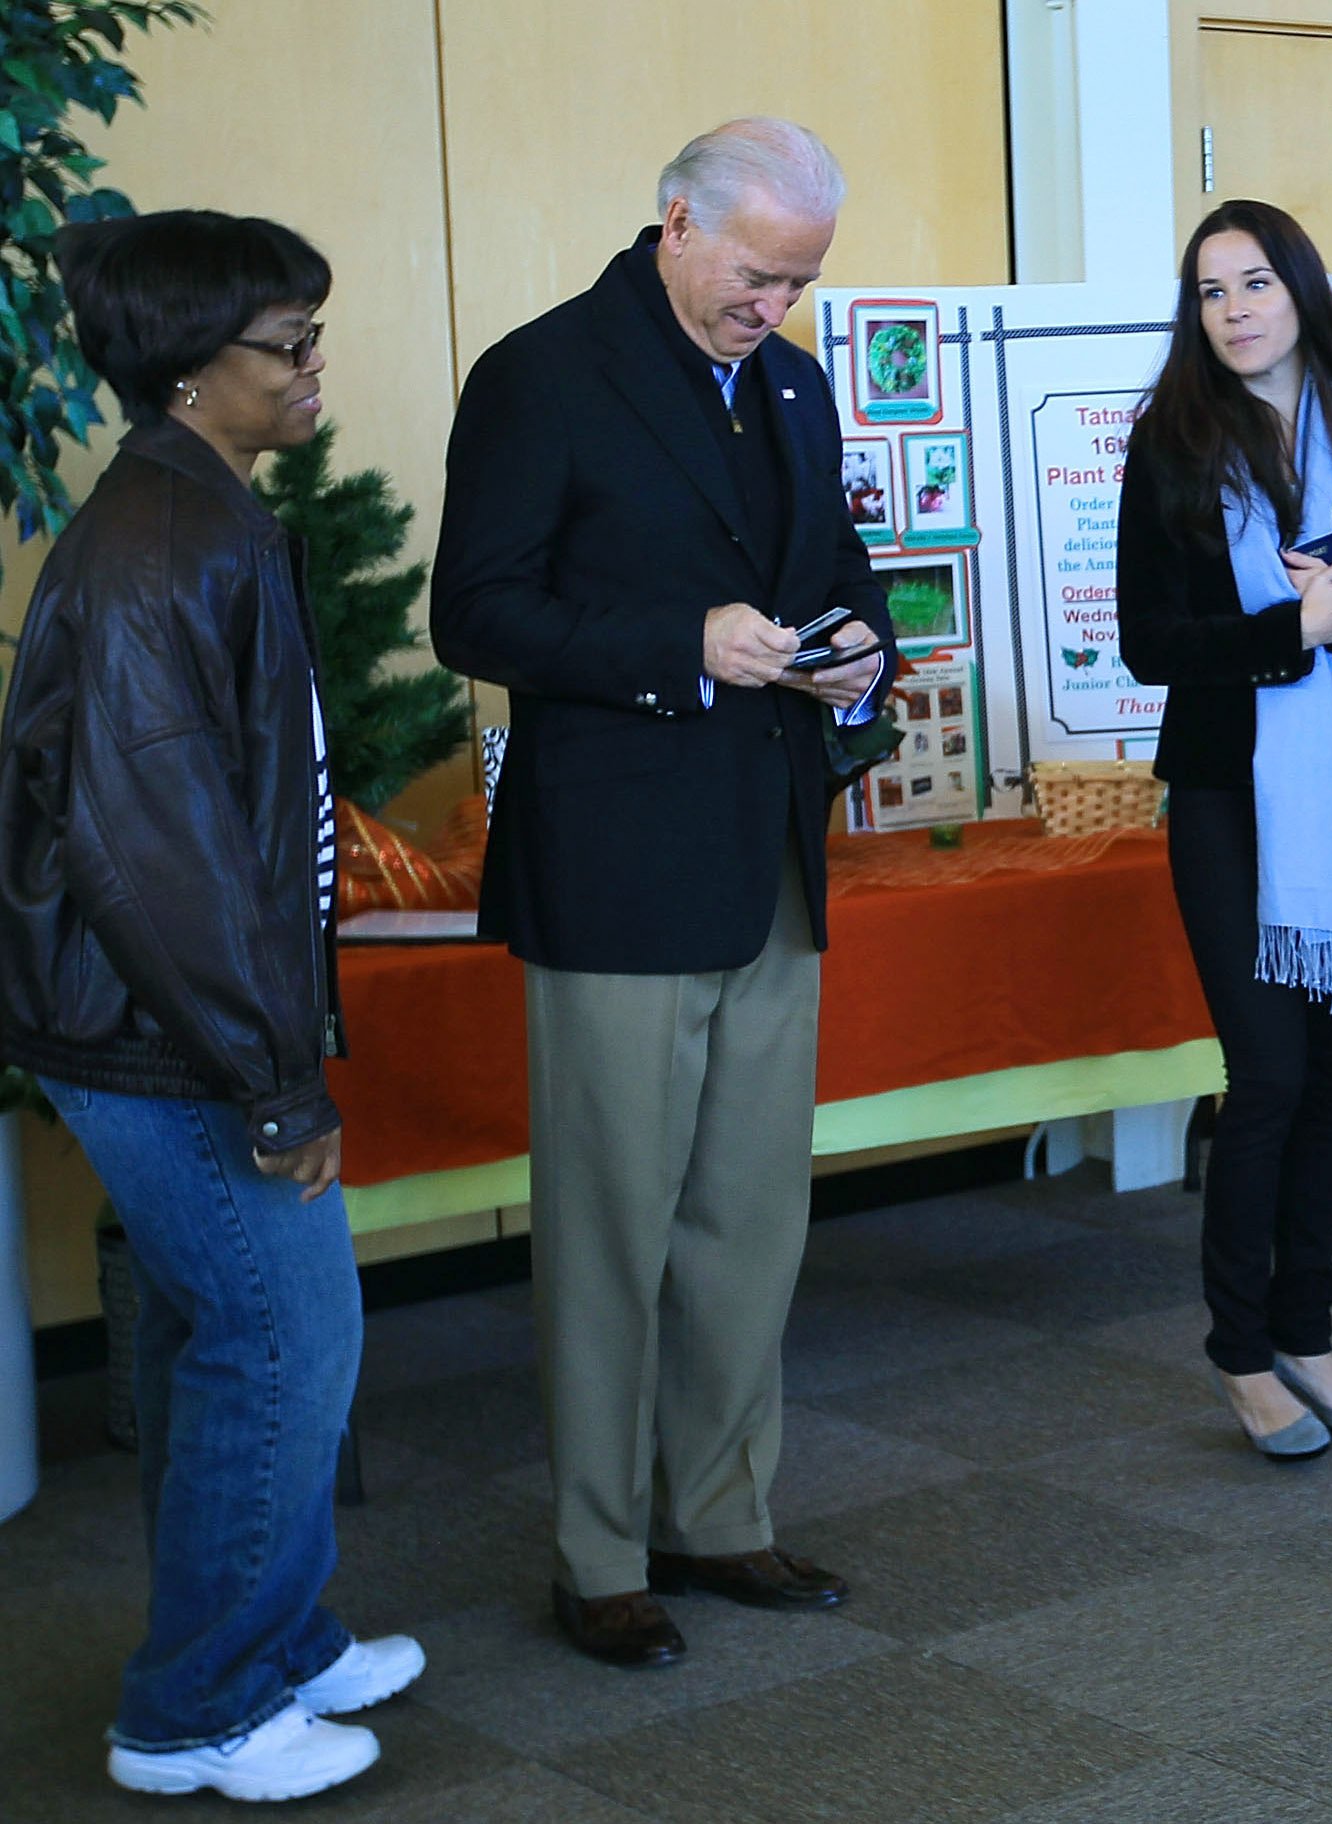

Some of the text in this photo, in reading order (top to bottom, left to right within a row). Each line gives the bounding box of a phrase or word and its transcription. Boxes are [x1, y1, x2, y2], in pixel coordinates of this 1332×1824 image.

[1047, 466, 1105, 485] Plant
[1070, 497, 1113, 511] Order
[1057, 559, 1081, 572] the
[1062, 678, 1111, 691] Junior
